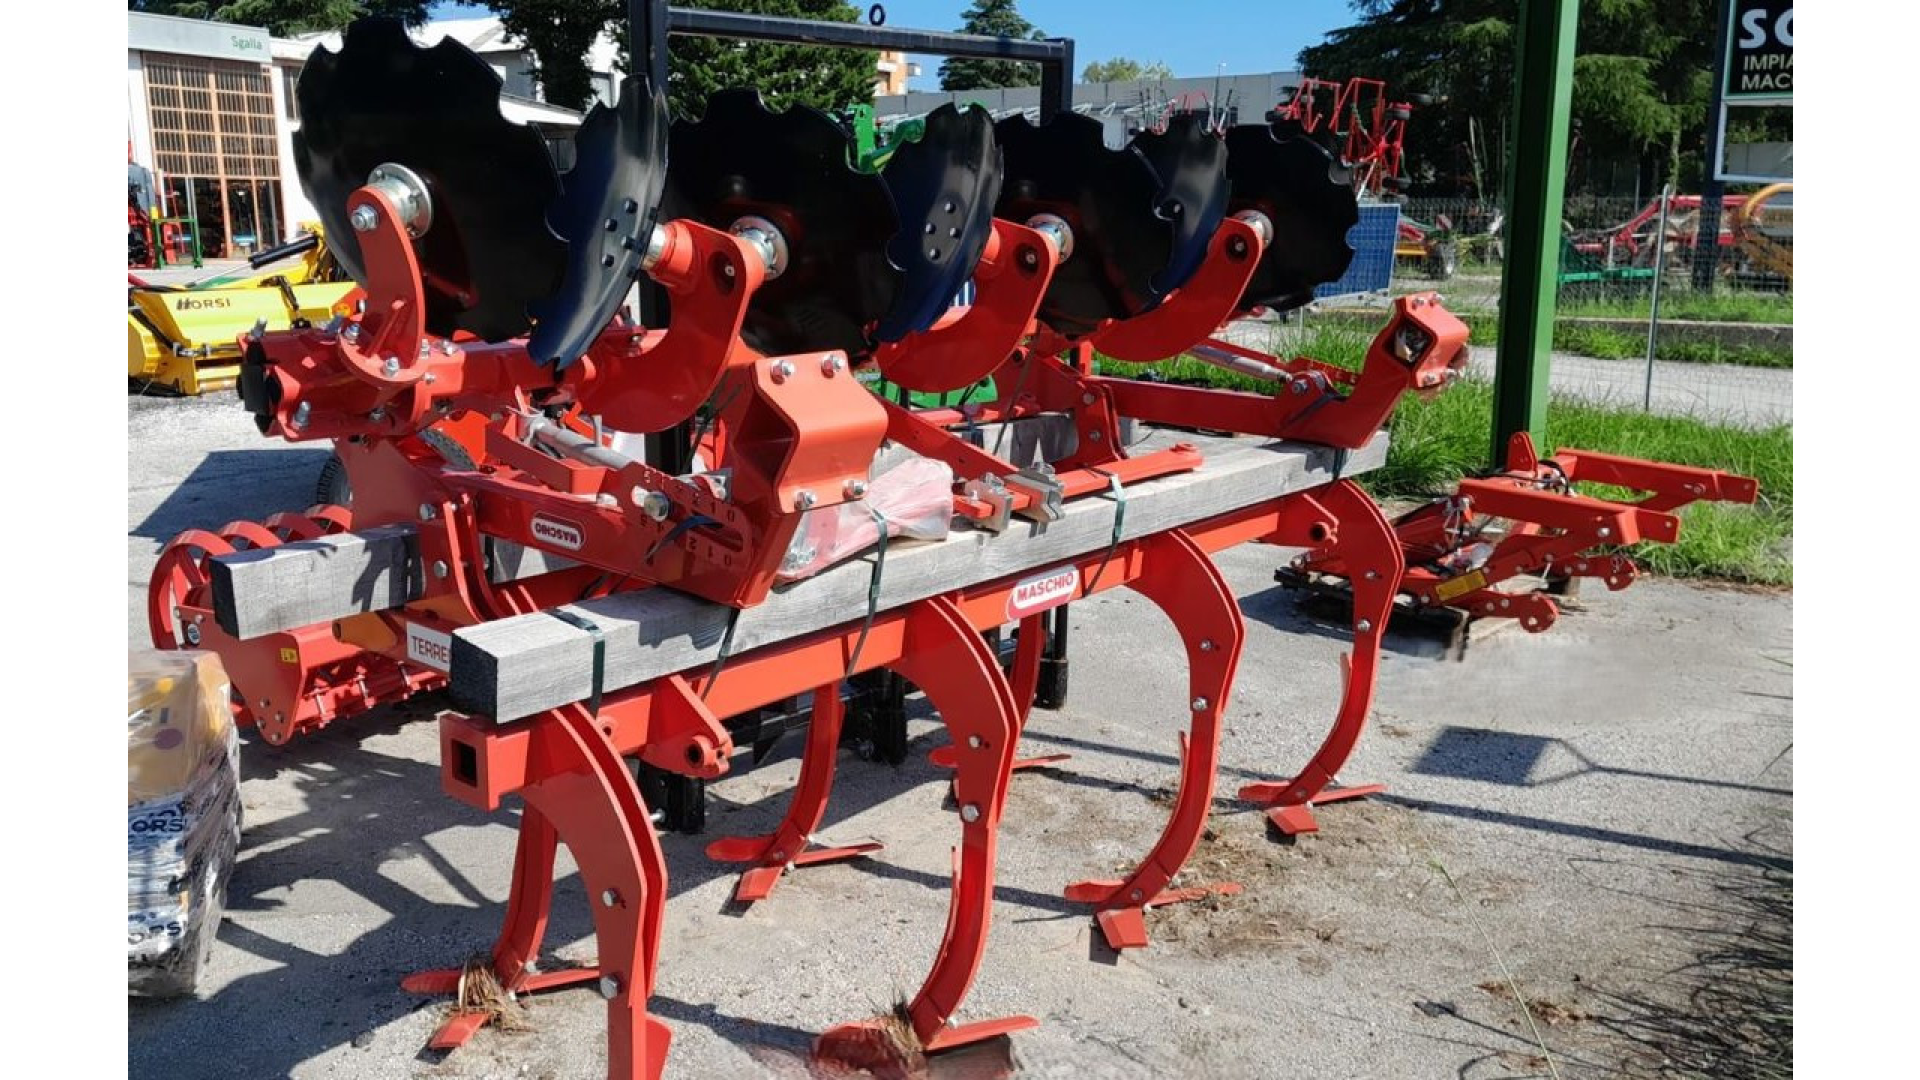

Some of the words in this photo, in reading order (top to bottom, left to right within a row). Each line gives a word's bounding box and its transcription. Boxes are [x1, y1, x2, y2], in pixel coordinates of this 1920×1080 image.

[1741, 72, 1793, 91] MAC
[535, 521, 579, 544] MASCHIO
[1018, 571, 1074, 601] MASCHIO
[411, 635, 450, 664] TERRE
